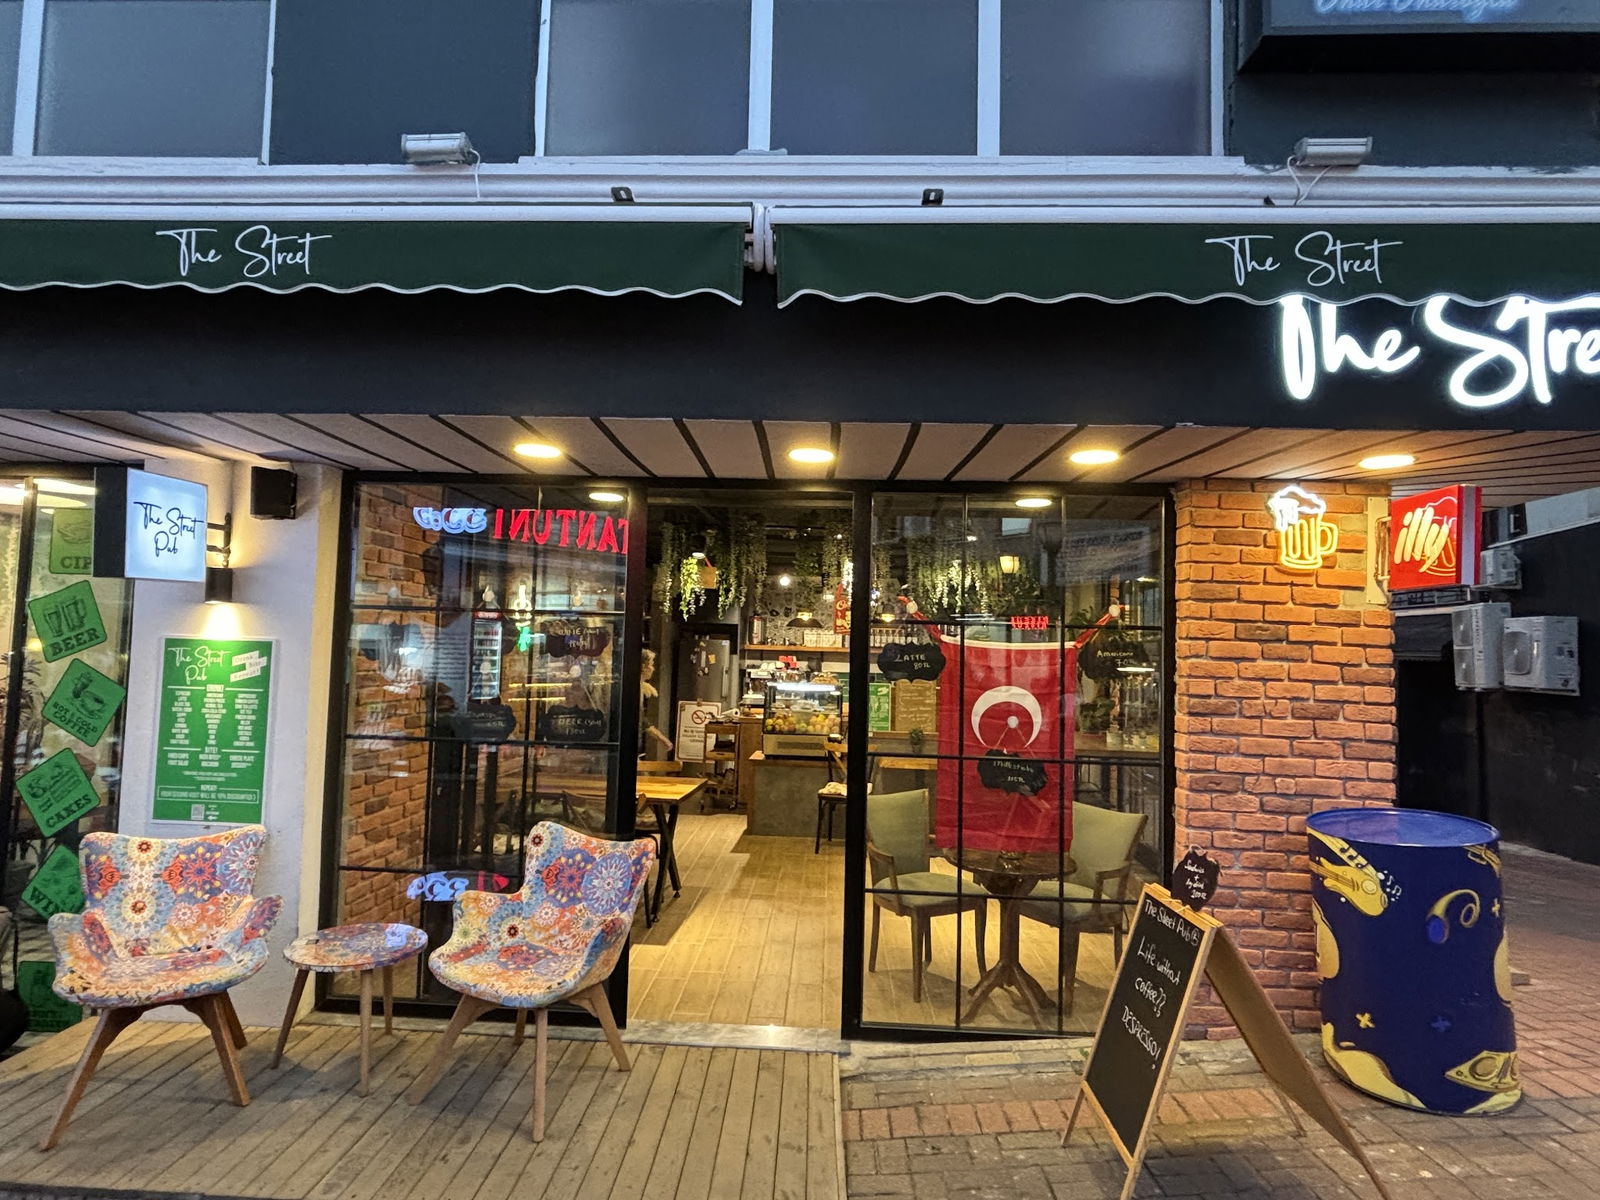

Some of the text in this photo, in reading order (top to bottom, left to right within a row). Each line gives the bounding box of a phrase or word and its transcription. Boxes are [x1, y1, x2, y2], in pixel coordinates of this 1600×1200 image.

[155, 225, 333, 278] The Street
[1205, 231, 1404, 286] The Street
[1279, 295, 1420, 400] The
[133, 501, 205, 540] The Street
[154, 530, 179, 558] Pub
[1393, 506, 1451, 573] illy
[48, 627, 100, 656] BEER
[167, 645, 232, 668] The Street
[894, 653, 926, 662] LATTE
[184, 664, 207, 685] Pub
[53, 710, 91, 738] COFFEE
[45, 794, 92, 828] CAKES
[30, 886, 62, 917] WIN
[1145, 899, 1157, 917] The
[1157, 906, 1176, 929] Street
[1137, 935, 1181, 985] Life without
[1135, 977, 1167, 1018] coffee??
